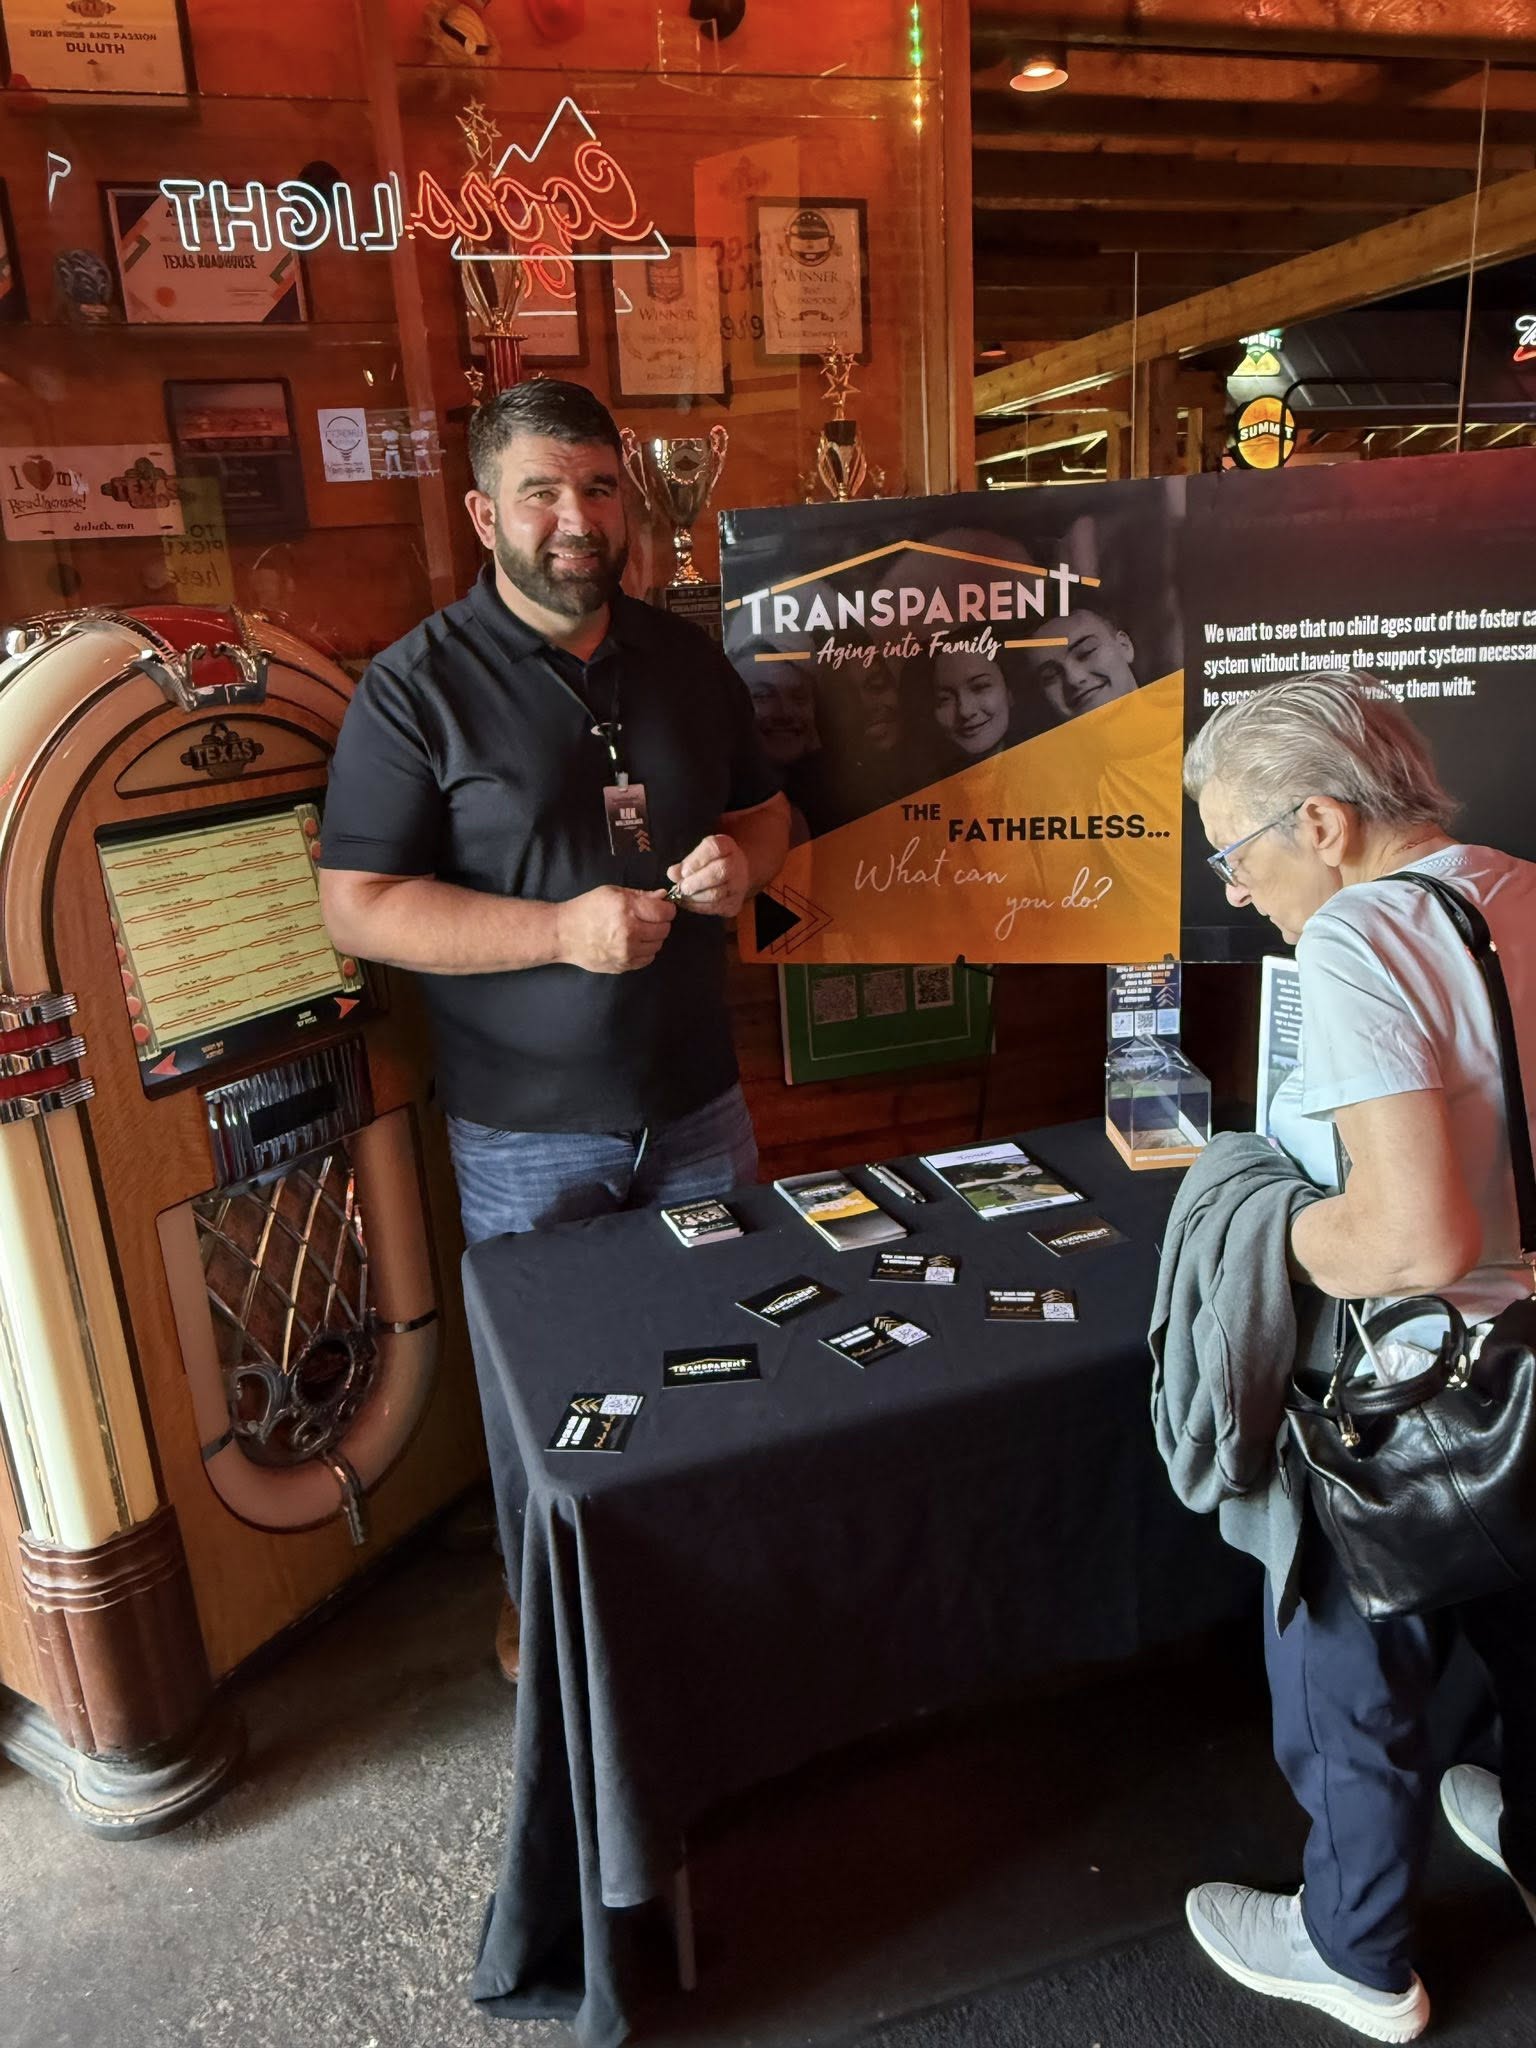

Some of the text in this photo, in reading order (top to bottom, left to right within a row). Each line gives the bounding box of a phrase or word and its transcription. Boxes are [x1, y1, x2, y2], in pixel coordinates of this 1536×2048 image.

[66, 42, 125, 54] DULUTH
[163, 254, 257, 269] TEXAS ROADHOUSE
[784, 269, 839, 283] WINNER
[640, 308, 697, 321] WINNER
[1240, 421, 1293, 440] SUMMT
[741, 563, 1079, 634] TRANSPARENT
[1204, 623, 1224, 643] We
[1226, 622, 1257, 642] want
[1259, 622, 1273, 640] to
[1275, 623, 1297, 640] see
[1300, 618, 1327, 638] that
[1328, 620, 1345, 637] no
[1347, 614, 1379, 636] child
[1381, 617, 1412, 638] ages
[1414, 613, 1437, 632] out
[1438, 610, 1454, 631] of
[1455, 609, 1477, 630] the
[1479, 608, 1521, 629] foster
[816, 626, 1001, 670] Aging into Family
[1203, 656, 1248, 679] system
[1251, 652, 1299, 673] without
[1301, 651, 1351, 673] haveing
[1353, 648, 1374, 668] the
[1376, 646, 1427, 671] support
[1428, 644, 1477, 669] system
[1203, 688, 1219, 707] be
[1406, 679, 1440, 698] them
[1442, 676, 1476, 697] with:
[194, 741, 253, 767] TEXAS
[902, 803, 941, 821] THE
[949, 814, 1171, 842] FATHERLESS...
[854, 836, 1007, 892] What can
[995, 866, 1114, 941] you do?
